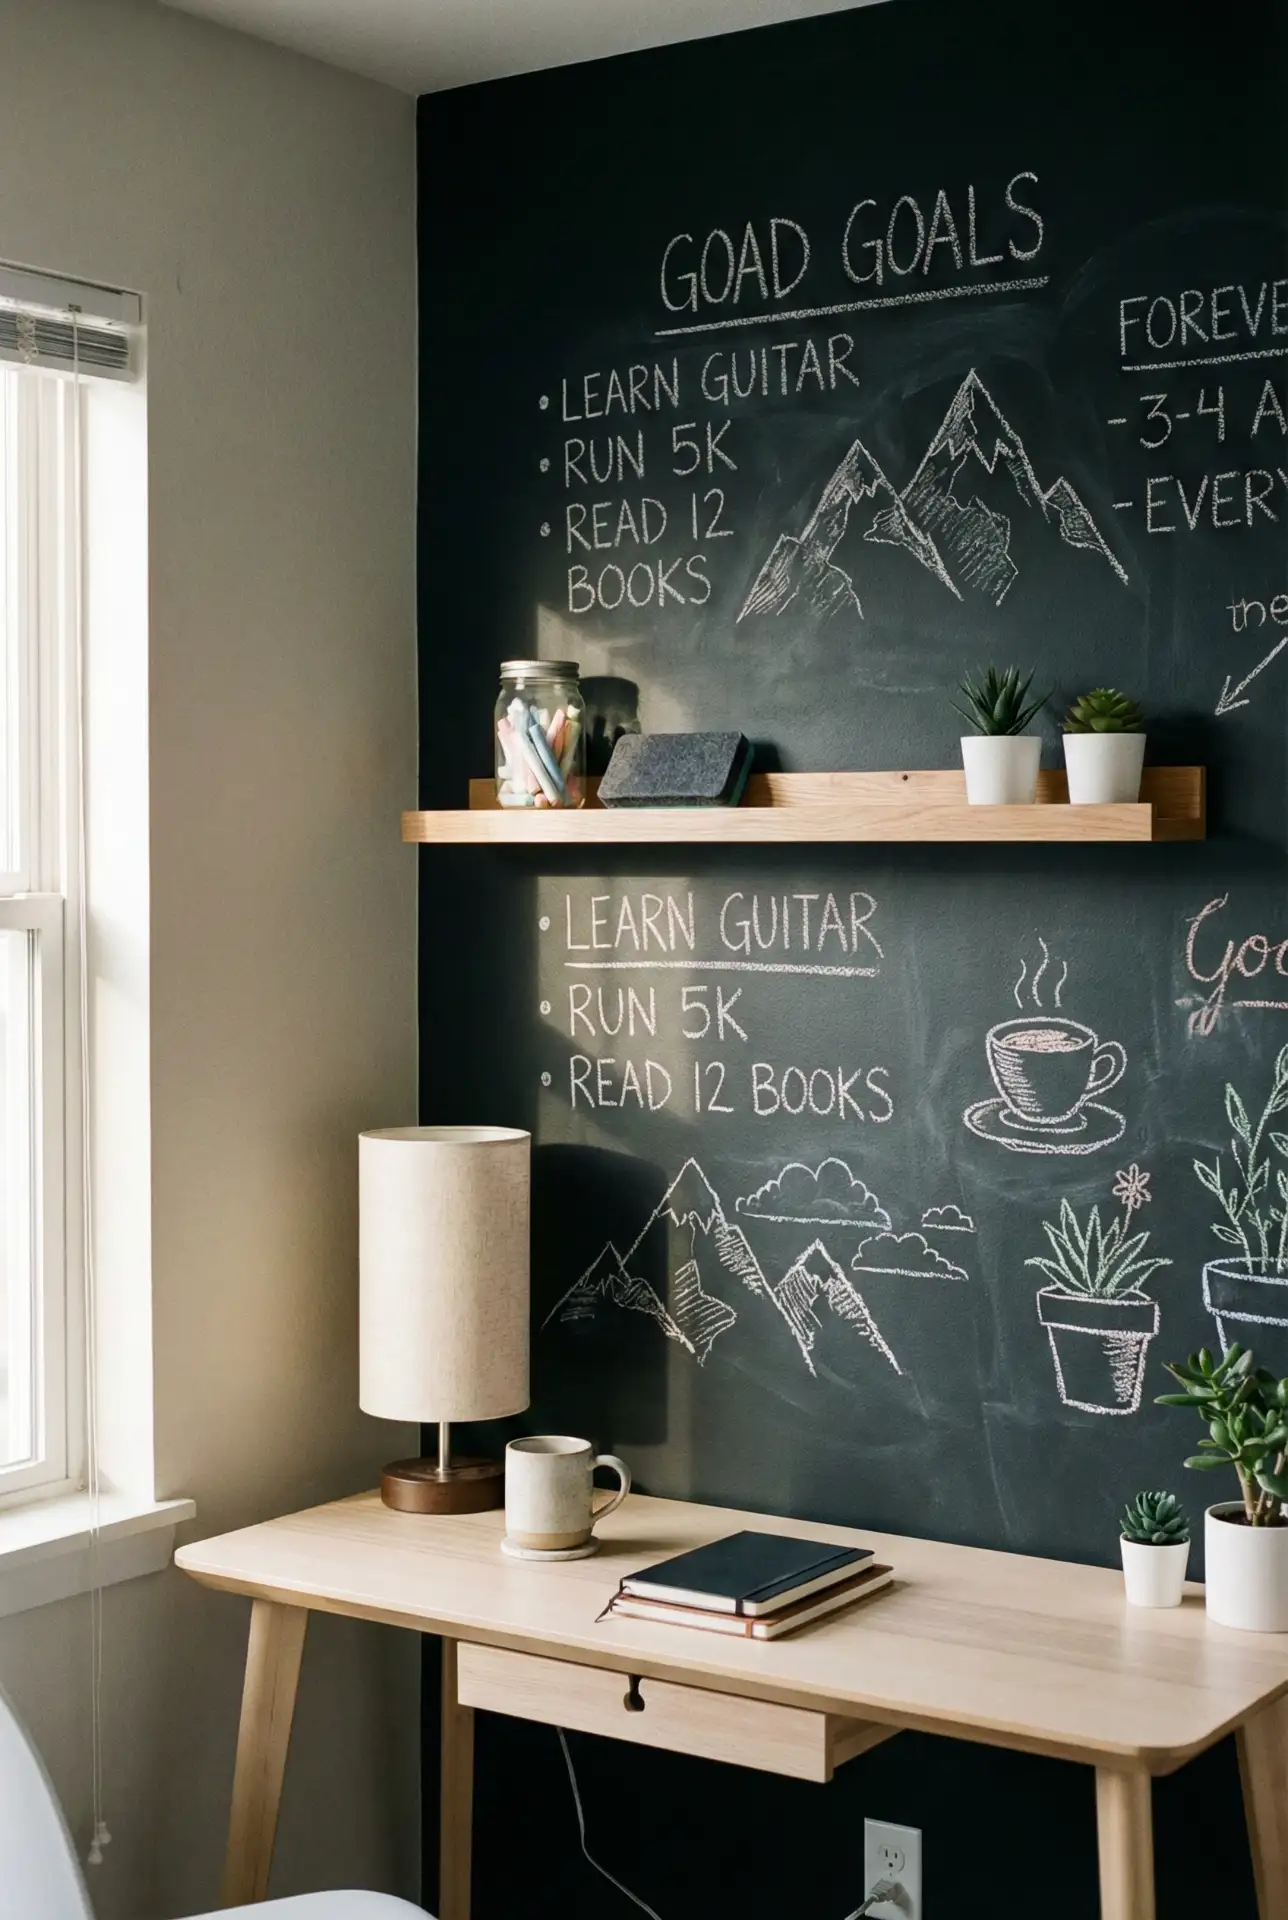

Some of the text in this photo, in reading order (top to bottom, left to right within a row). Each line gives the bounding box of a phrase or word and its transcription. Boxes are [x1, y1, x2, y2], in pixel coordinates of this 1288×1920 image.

[661, 171, 1044, 312] GOAD GOALS
[562, 333, 859, 422] LEARN GUITAR
[565, 420, 737, 487] RUN 5K
[566, 492, 734, 553] READ 12
[567, 555, 711, 613] BOOKS
[566, 892, 884, 958] LEARN GUITAR
[569, 984, 748, 1041] RUN 5K
[570, 1055, 894, 1123] READ 12 BOOKS
